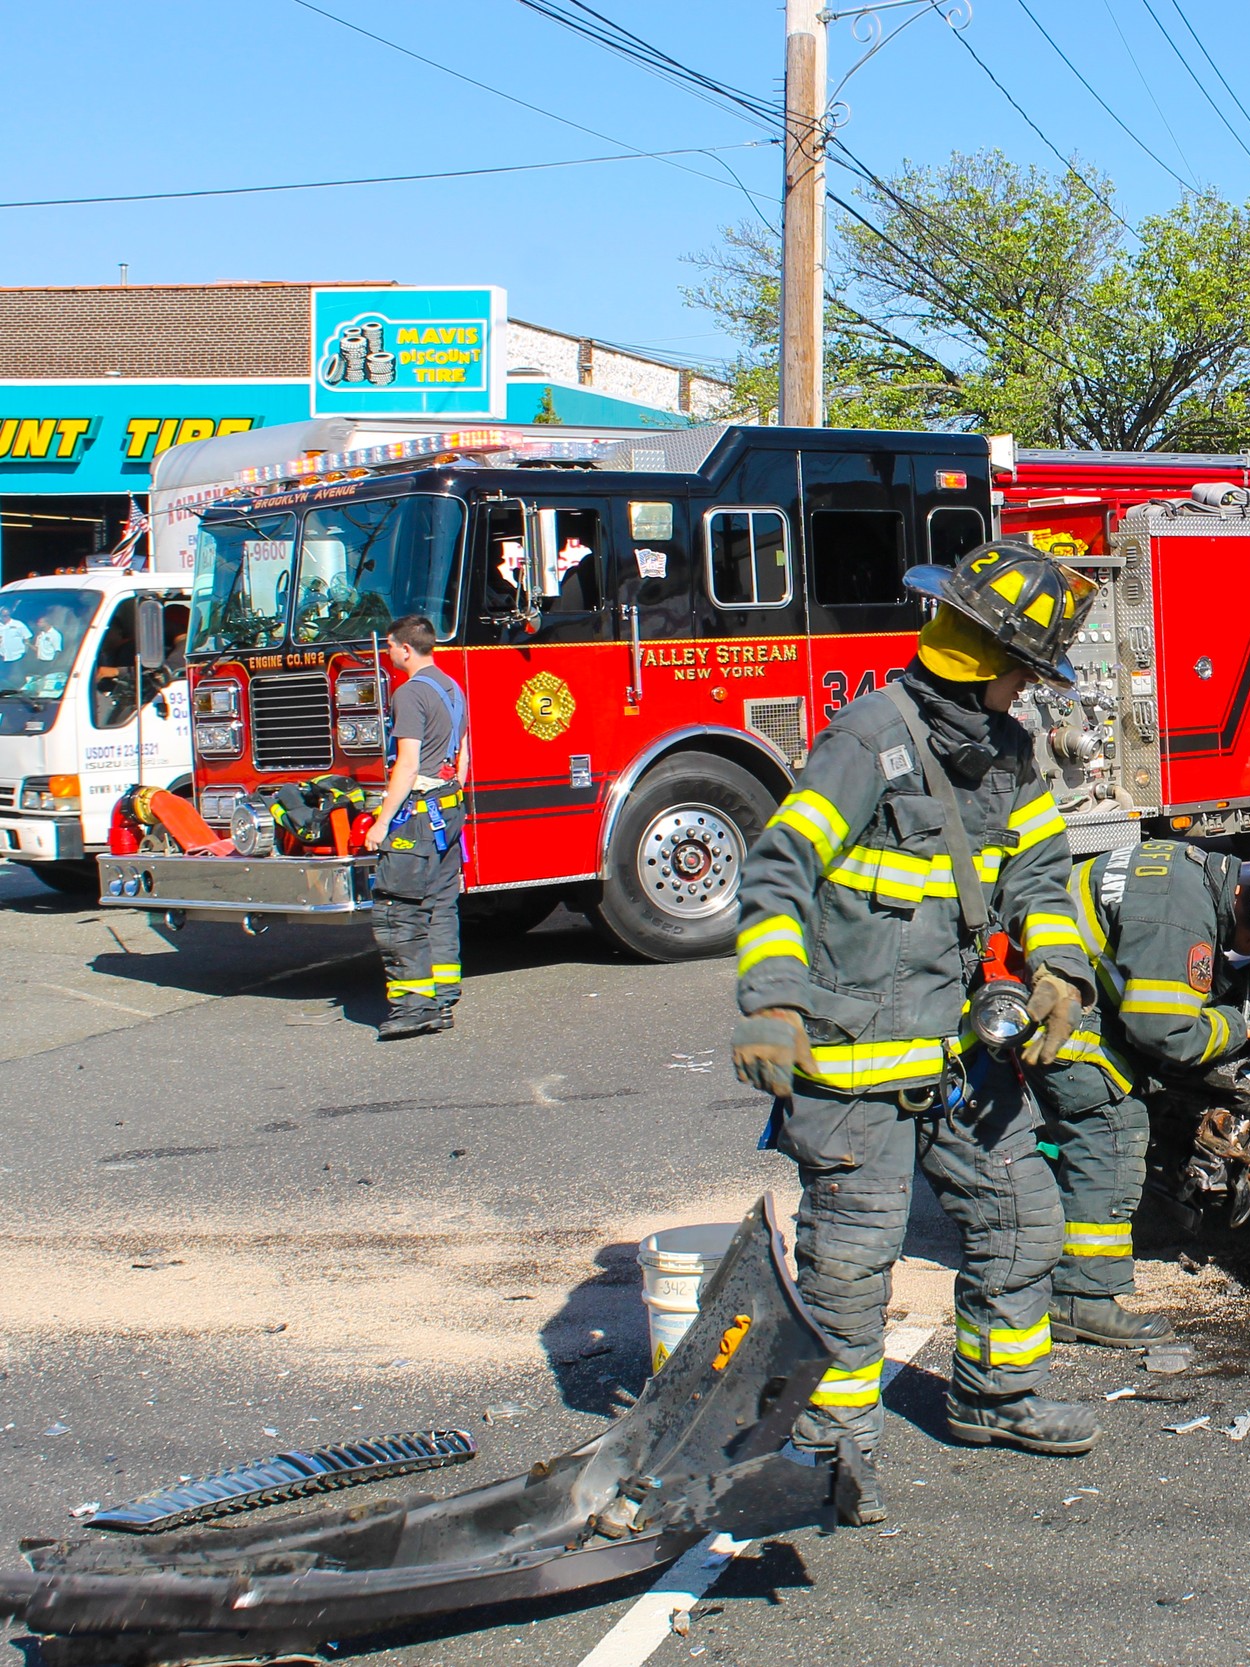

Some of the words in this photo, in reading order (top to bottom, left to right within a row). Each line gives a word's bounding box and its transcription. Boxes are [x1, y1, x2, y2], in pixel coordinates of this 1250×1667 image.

[397, 328, 478, 344] MAVIS
[400, 348, 480, 365] DISCOUNT
[414, 368, 466, 383] TIRE
[970, 551, 1000, 574] 2
[248, 654, 284, 669] ENGINE
[715, 643, 797, 664] STREAM
[674, 667, 712, 681] NEW
[721, 665, 766, 679] YORK
[823, 667, 907, 722] 34
[539, 697, 553, 716] 2
[86, 745, 116, 760] USDOT
[85, 761, 121, 770] ISUZU
